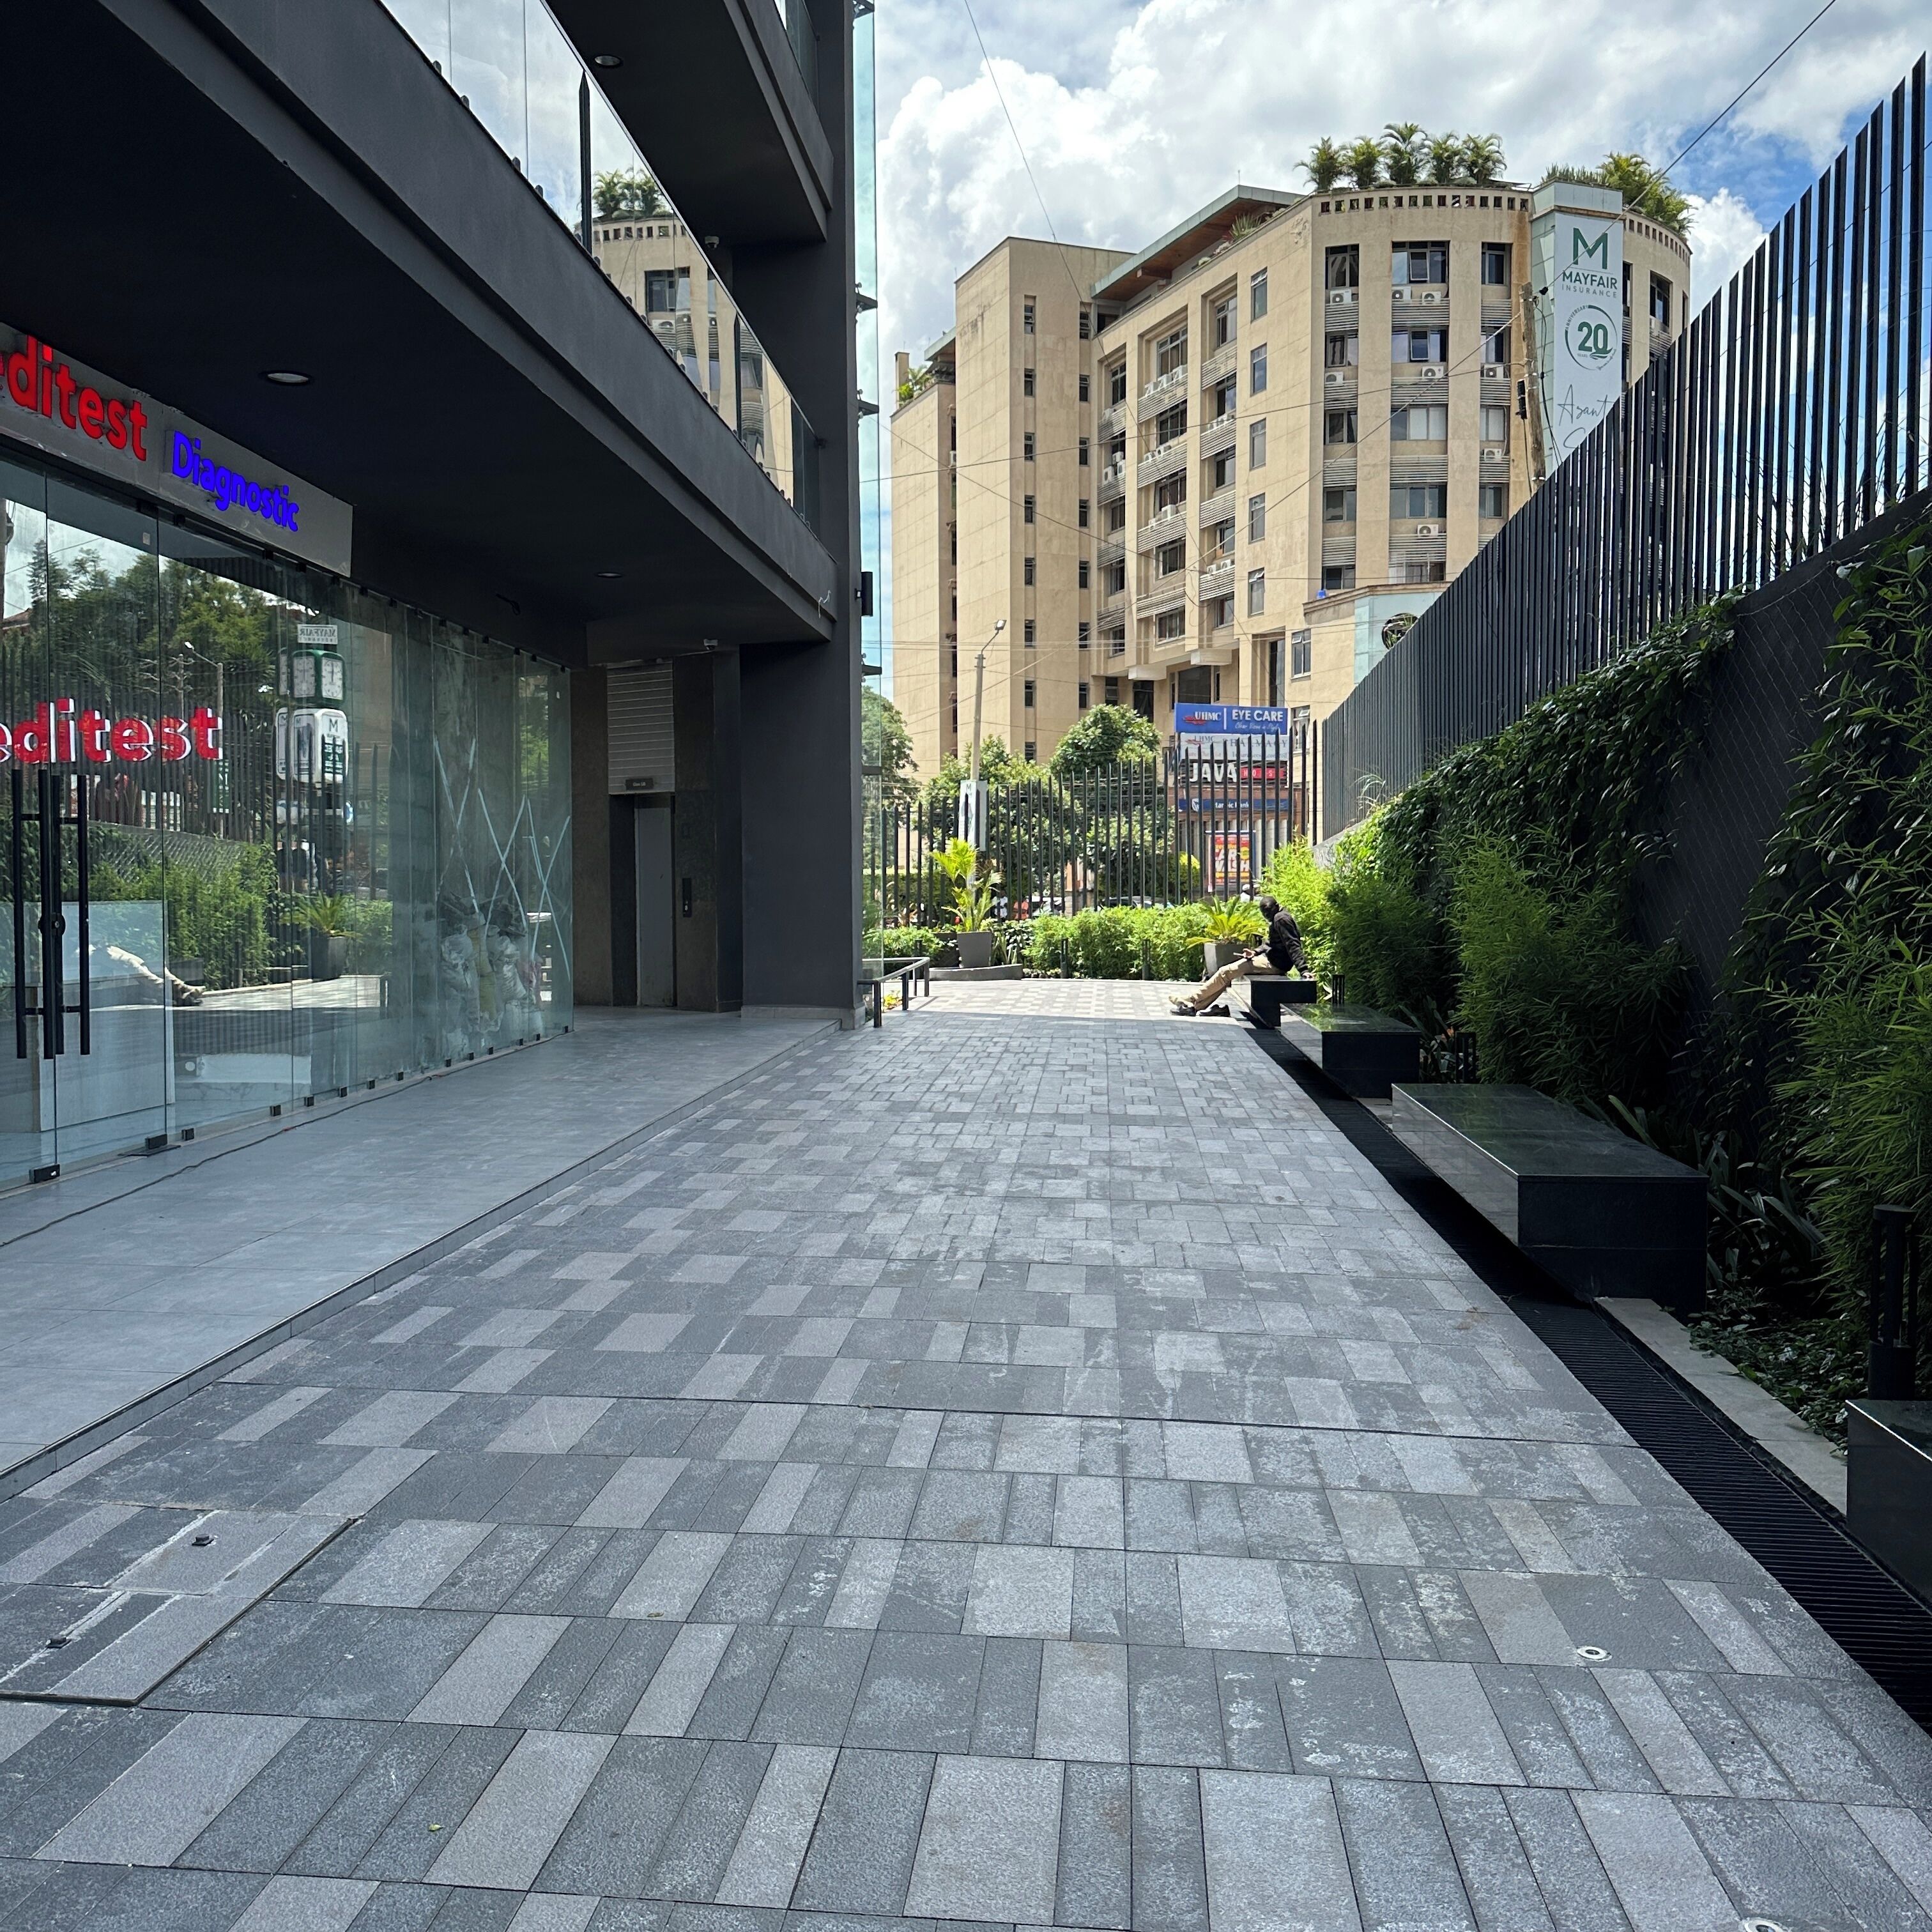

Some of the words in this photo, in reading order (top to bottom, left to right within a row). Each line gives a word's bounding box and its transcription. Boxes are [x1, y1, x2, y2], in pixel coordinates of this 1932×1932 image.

[1572, 227, 1608, 270] M
[1561, 284, 1617, 298] INSURANCE
[1562, 270, 1618, 290] MAYFAIR
[1578, 321, 1609, 355] 20
[1558, 384, 1615, 426] Asant
[0, 335, 148, 461] ditest
[172, 430, 299, 532] Diagnostic
[0, 698, 222, 764] ditest
[1232, 709, 1251, 721] EYE
[1254, 710, 1284, 722] CARE
[1189, 762, 1238, 782] JAVA
